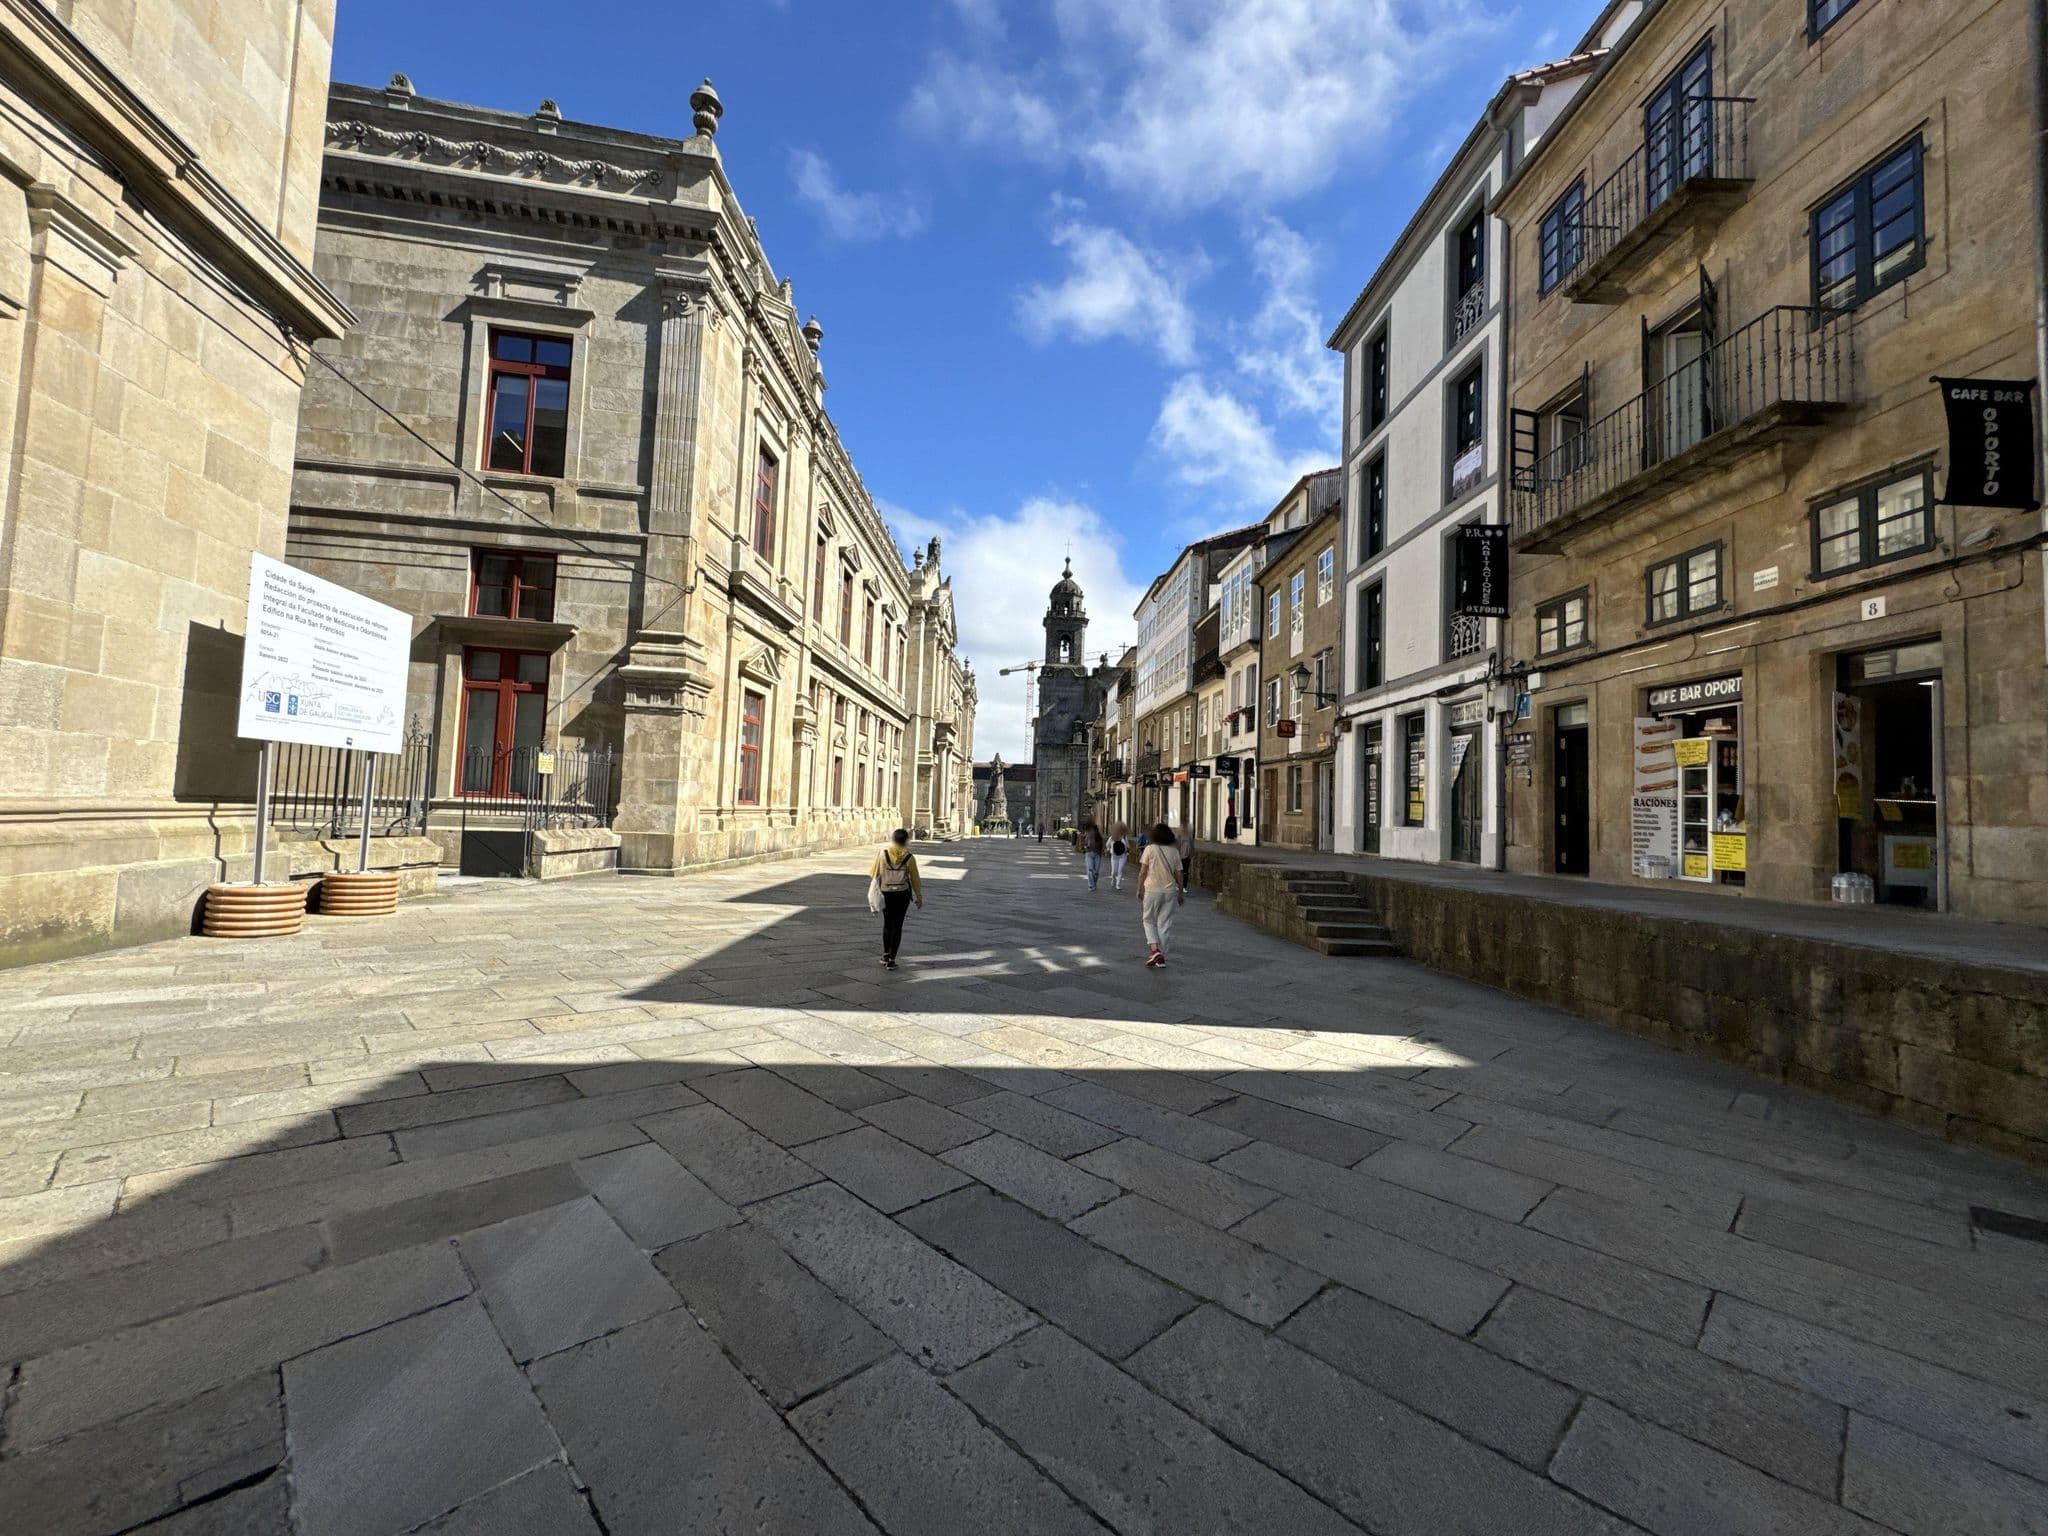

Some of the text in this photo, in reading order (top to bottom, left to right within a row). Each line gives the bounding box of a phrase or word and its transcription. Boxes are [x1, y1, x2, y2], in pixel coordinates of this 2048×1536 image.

[1951, 388, 2024, 403] CAFE BAR
[1983, 407, 2000, 496] OPORTO
[265, 570, 287, 584] Cidade
[289, 579, 296, 587] da
[1466, 605, 1505, 615] OXFORD
[1868, 602, 1878, 616] 8
[308, 619, 318, 628] San
[1649, 676, 1744, 706] CAFE BAR OPORT
